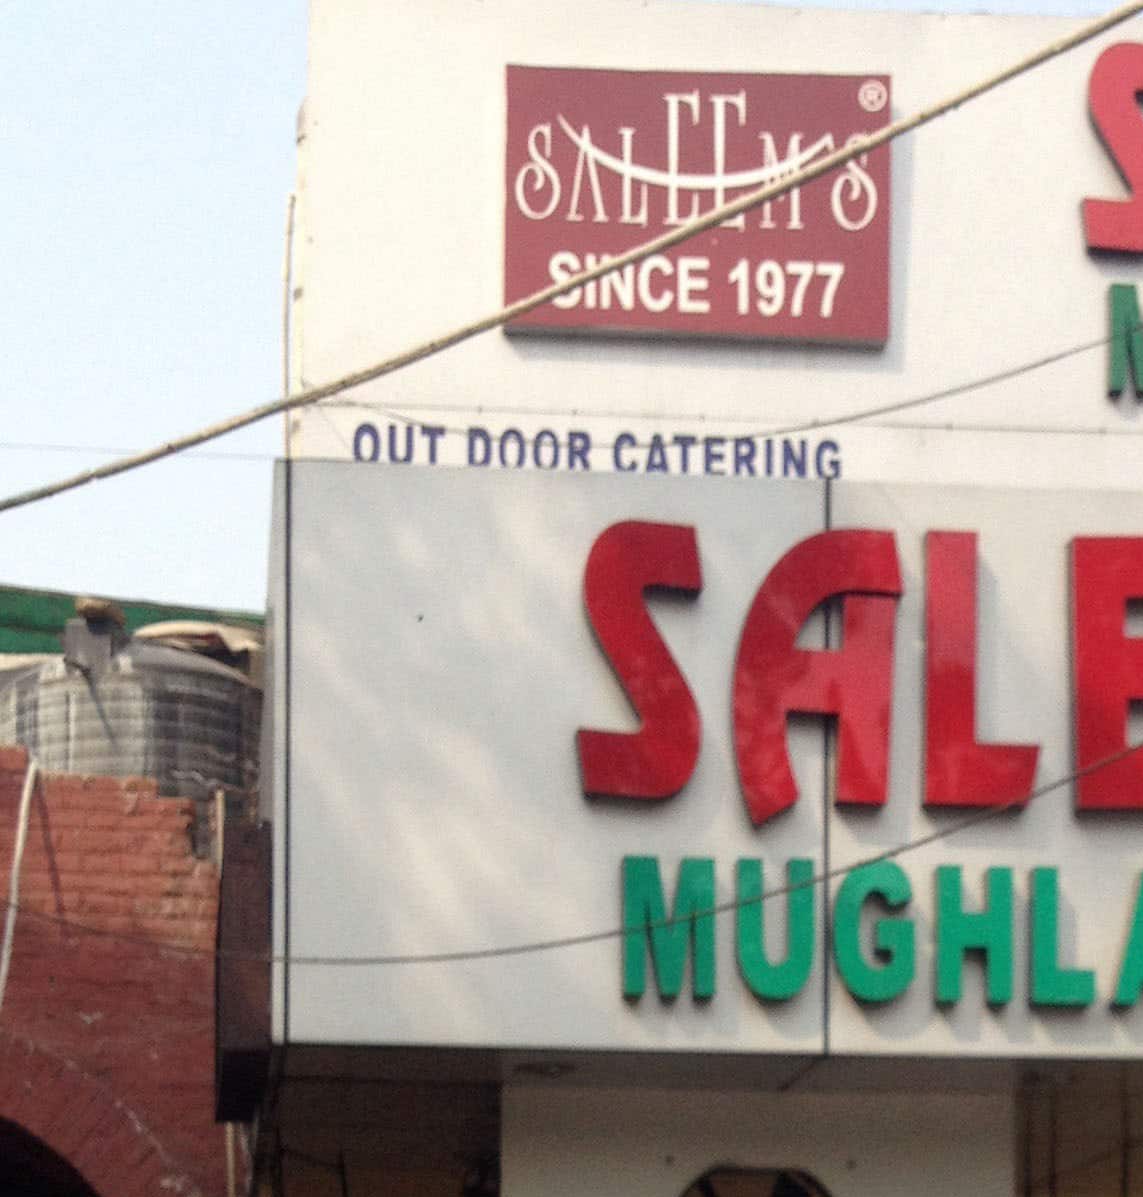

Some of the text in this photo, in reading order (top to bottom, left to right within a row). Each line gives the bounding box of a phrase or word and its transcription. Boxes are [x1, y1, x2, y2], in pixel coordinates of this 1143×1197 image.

[547, 251, 846, 319] SINCE 1977
[353, 423, 841, 480] OUT DOOR CATERING
